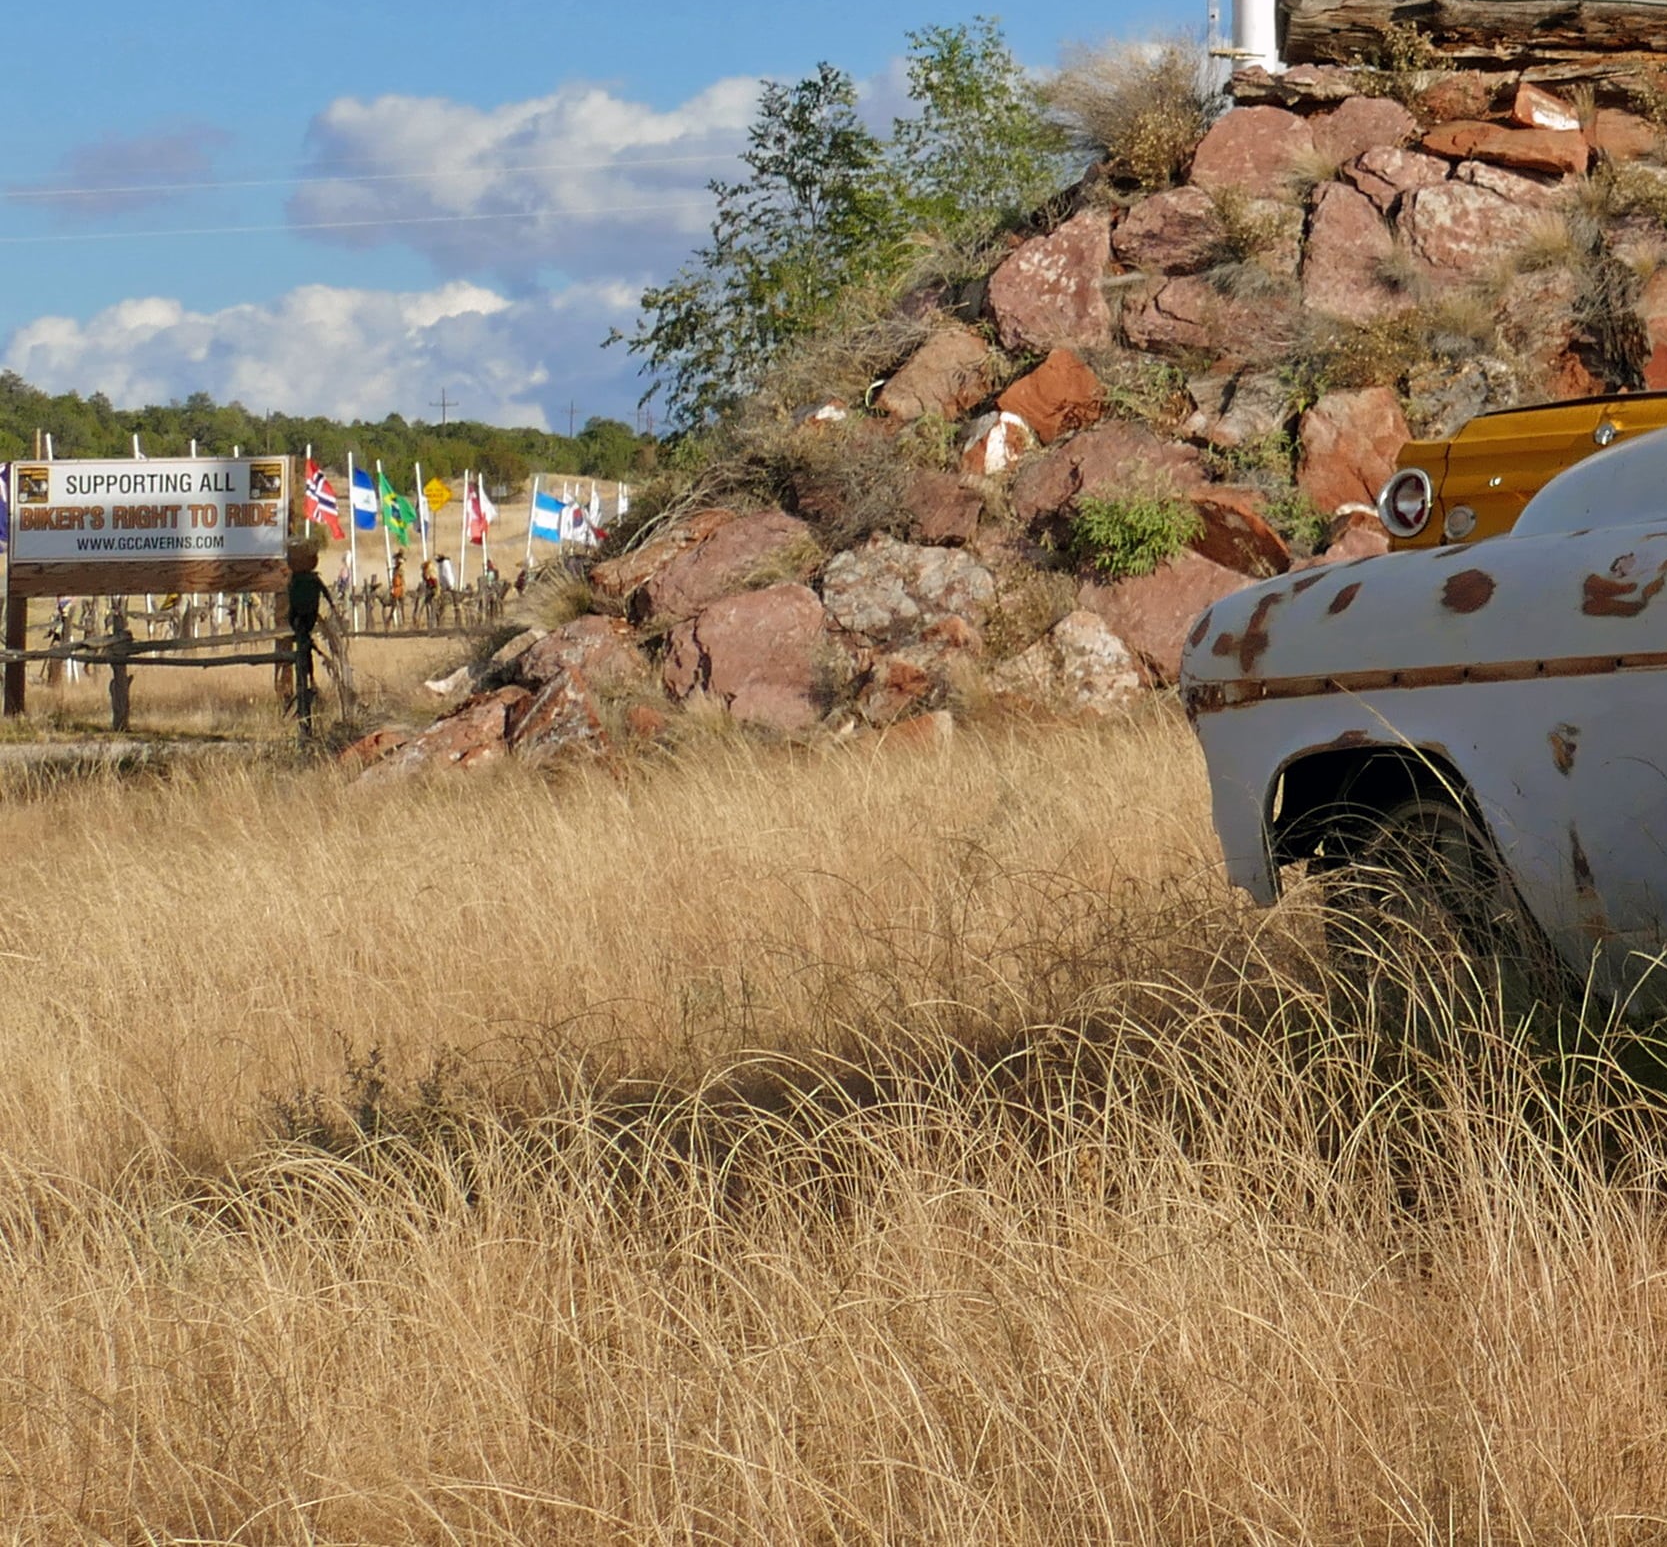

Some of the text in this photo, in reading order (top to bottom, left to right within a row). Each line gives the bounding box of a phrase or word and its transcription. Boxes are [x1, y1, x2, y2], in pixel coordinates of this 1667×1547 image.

[66, 473, 192, 494] SUPPORTING
[200, 472, 235, 492] ALL
[20, 503, 278, 532] BIKER'S RIGHT TO RIDE
[77, 535, 224, 551] WWW.GCCAVERNS.COM
